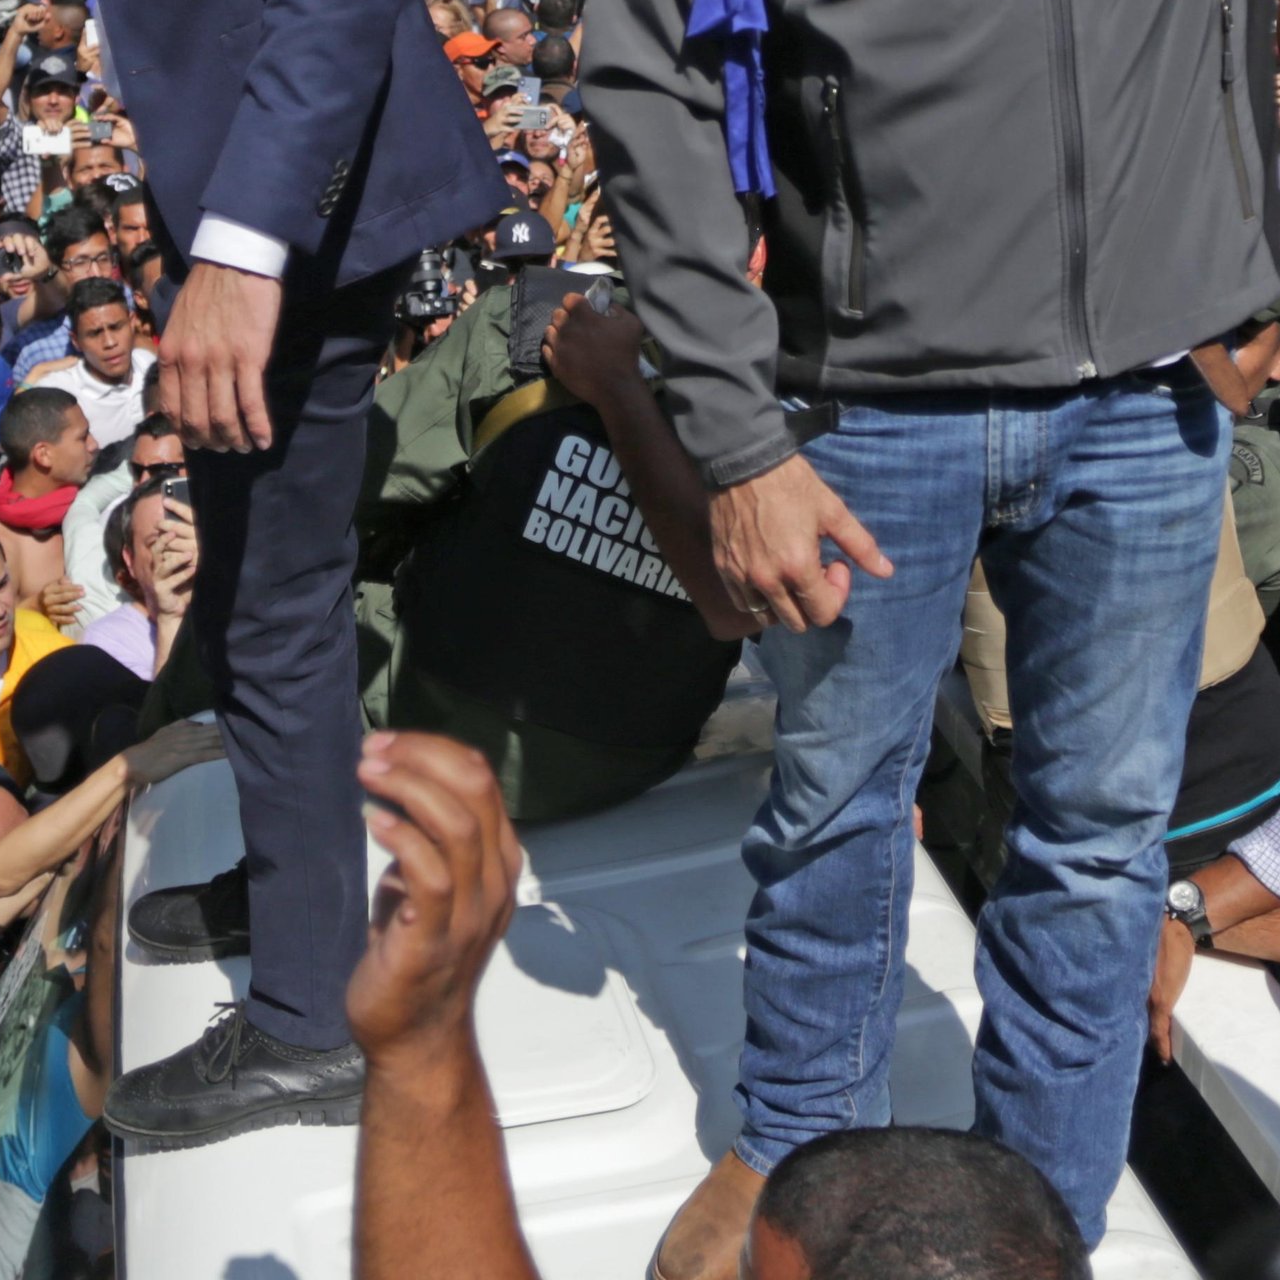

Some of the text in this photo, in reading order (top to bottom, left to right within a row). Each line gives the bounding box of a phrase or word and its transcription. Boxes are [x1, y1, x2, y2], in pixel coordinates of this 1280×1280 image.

[554, 435, 632, 499] GU
[1237, 447, 1261, 477] CAPITAL
[522, 507, 694, 604] BOLIVARIA
